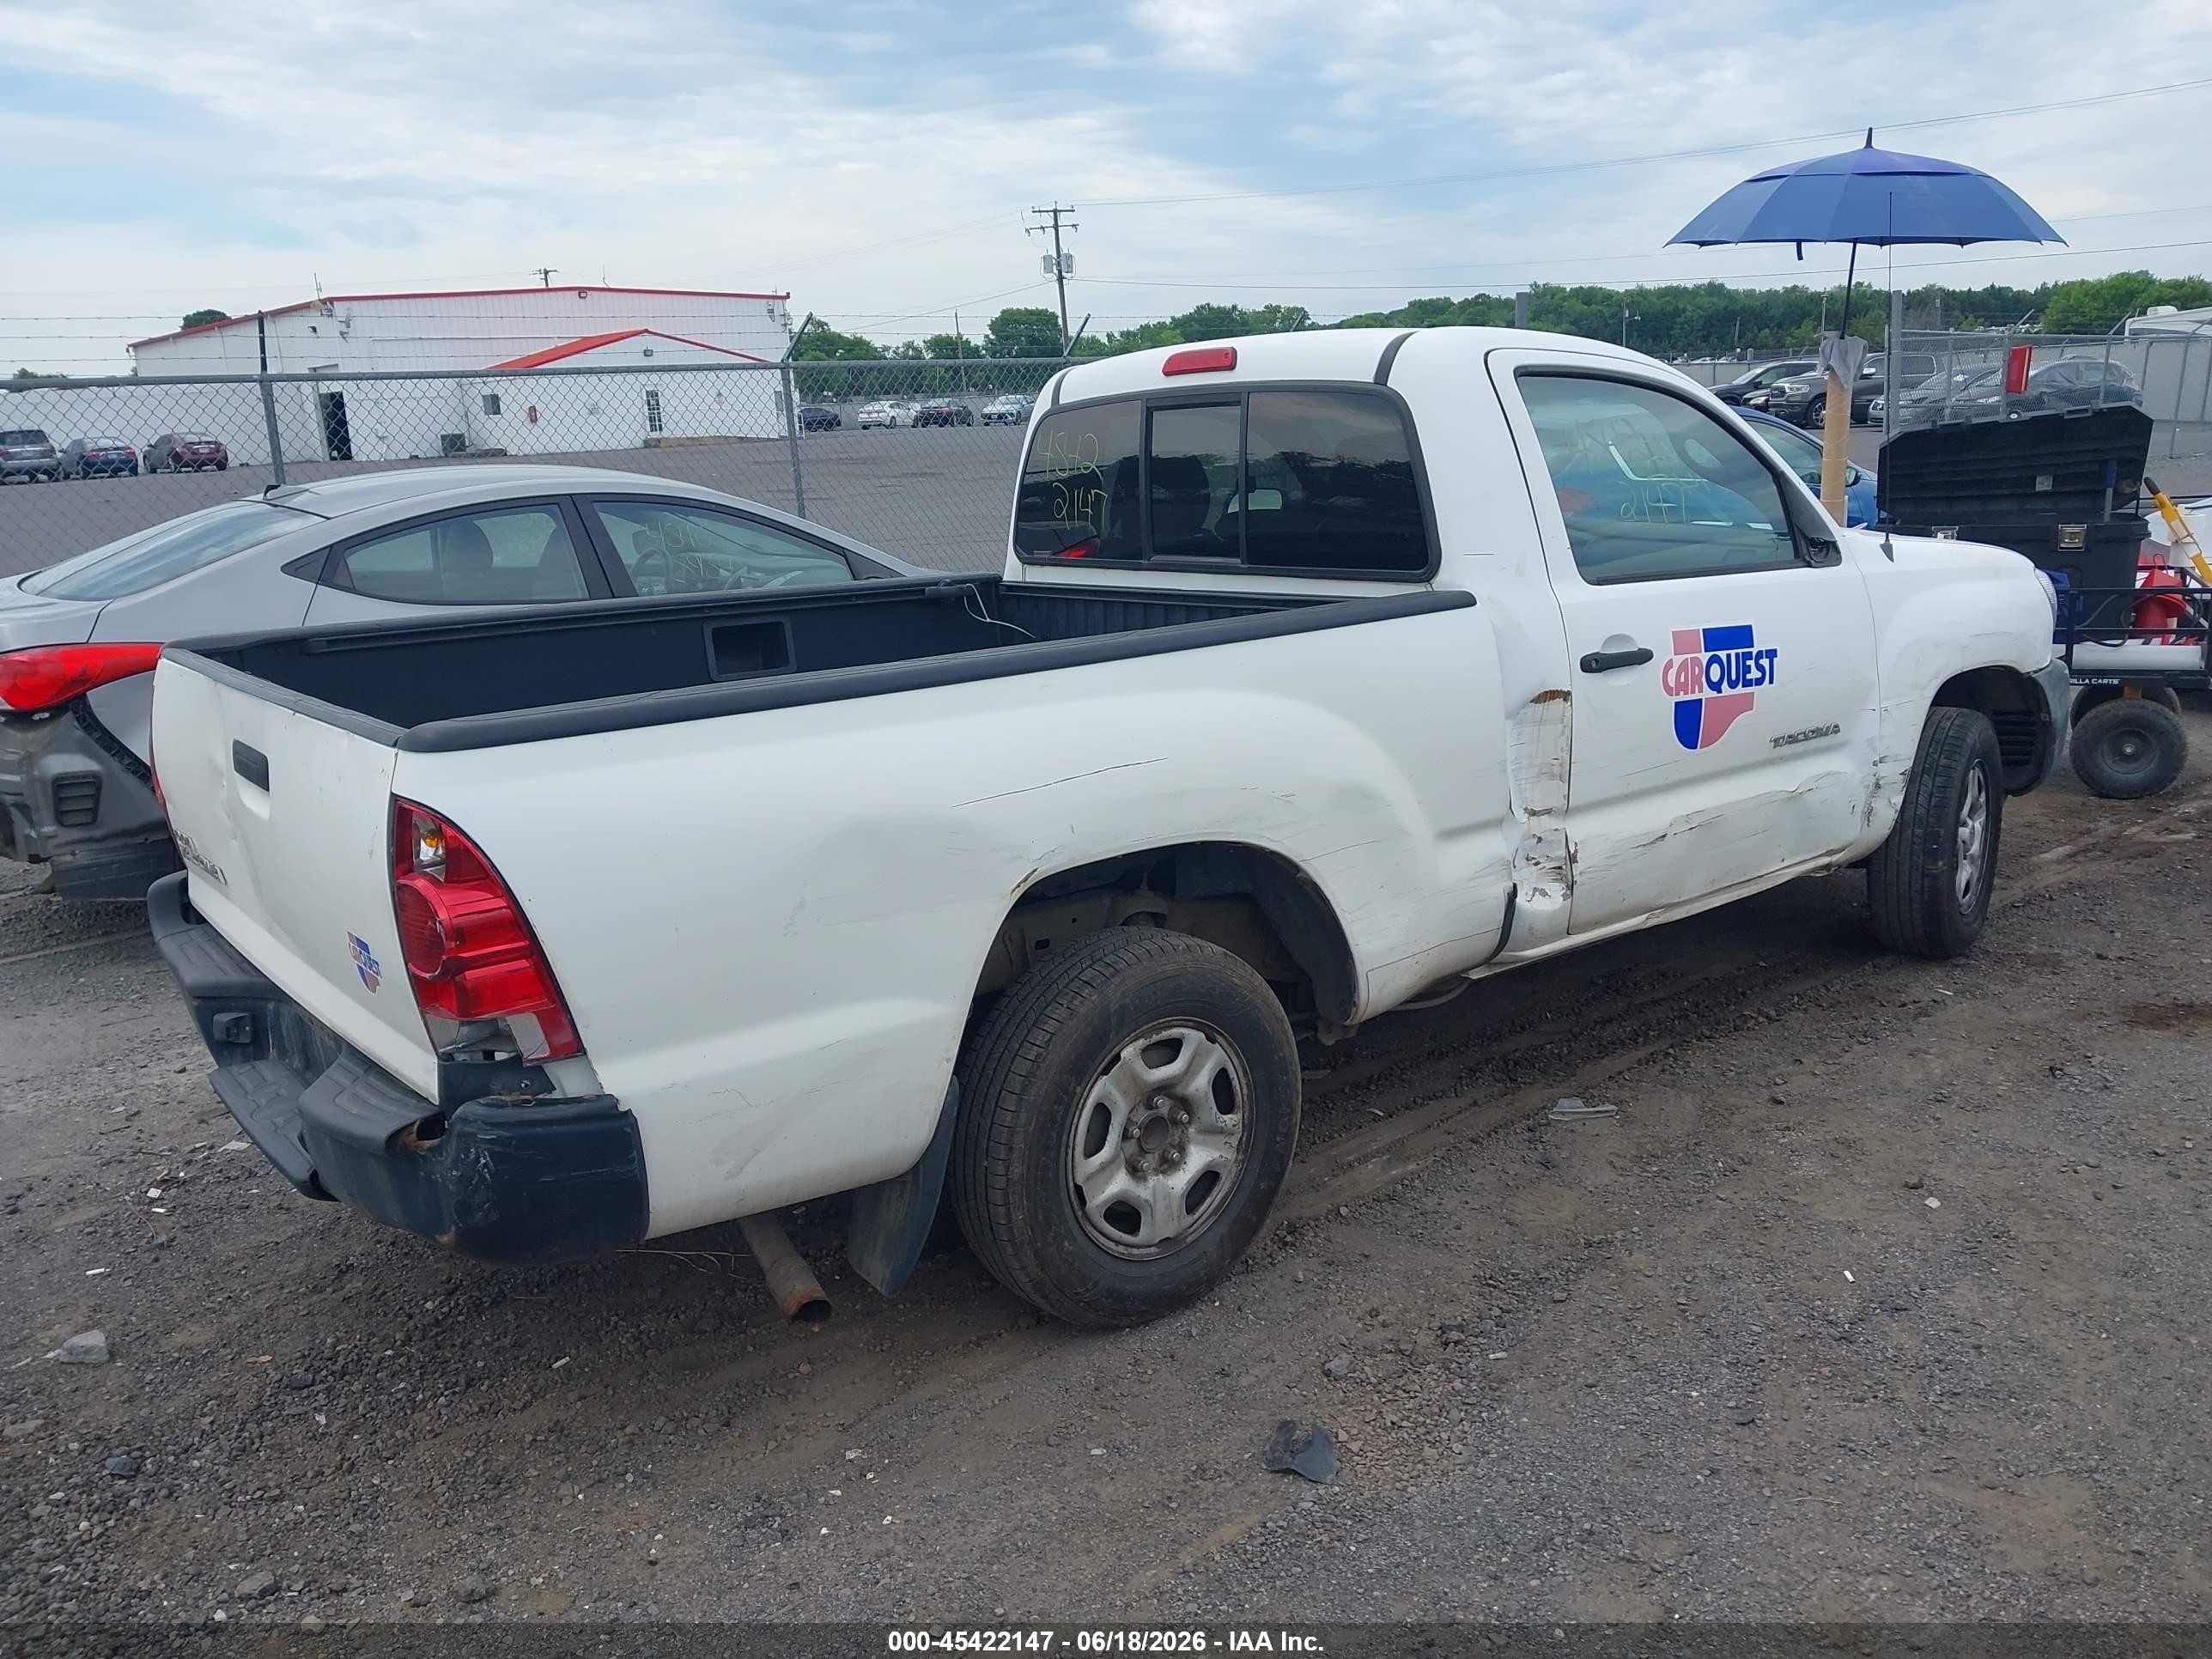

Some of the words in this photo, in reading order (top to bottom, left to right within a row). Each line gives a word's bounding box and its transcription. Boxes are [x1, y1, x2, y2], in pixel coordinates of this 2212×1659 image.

[1052, 482, 1109, 531] 2147
[1662, 647, 1778, 696] CARQUEST
[1769, 721, 1842, 749] TACOMA
